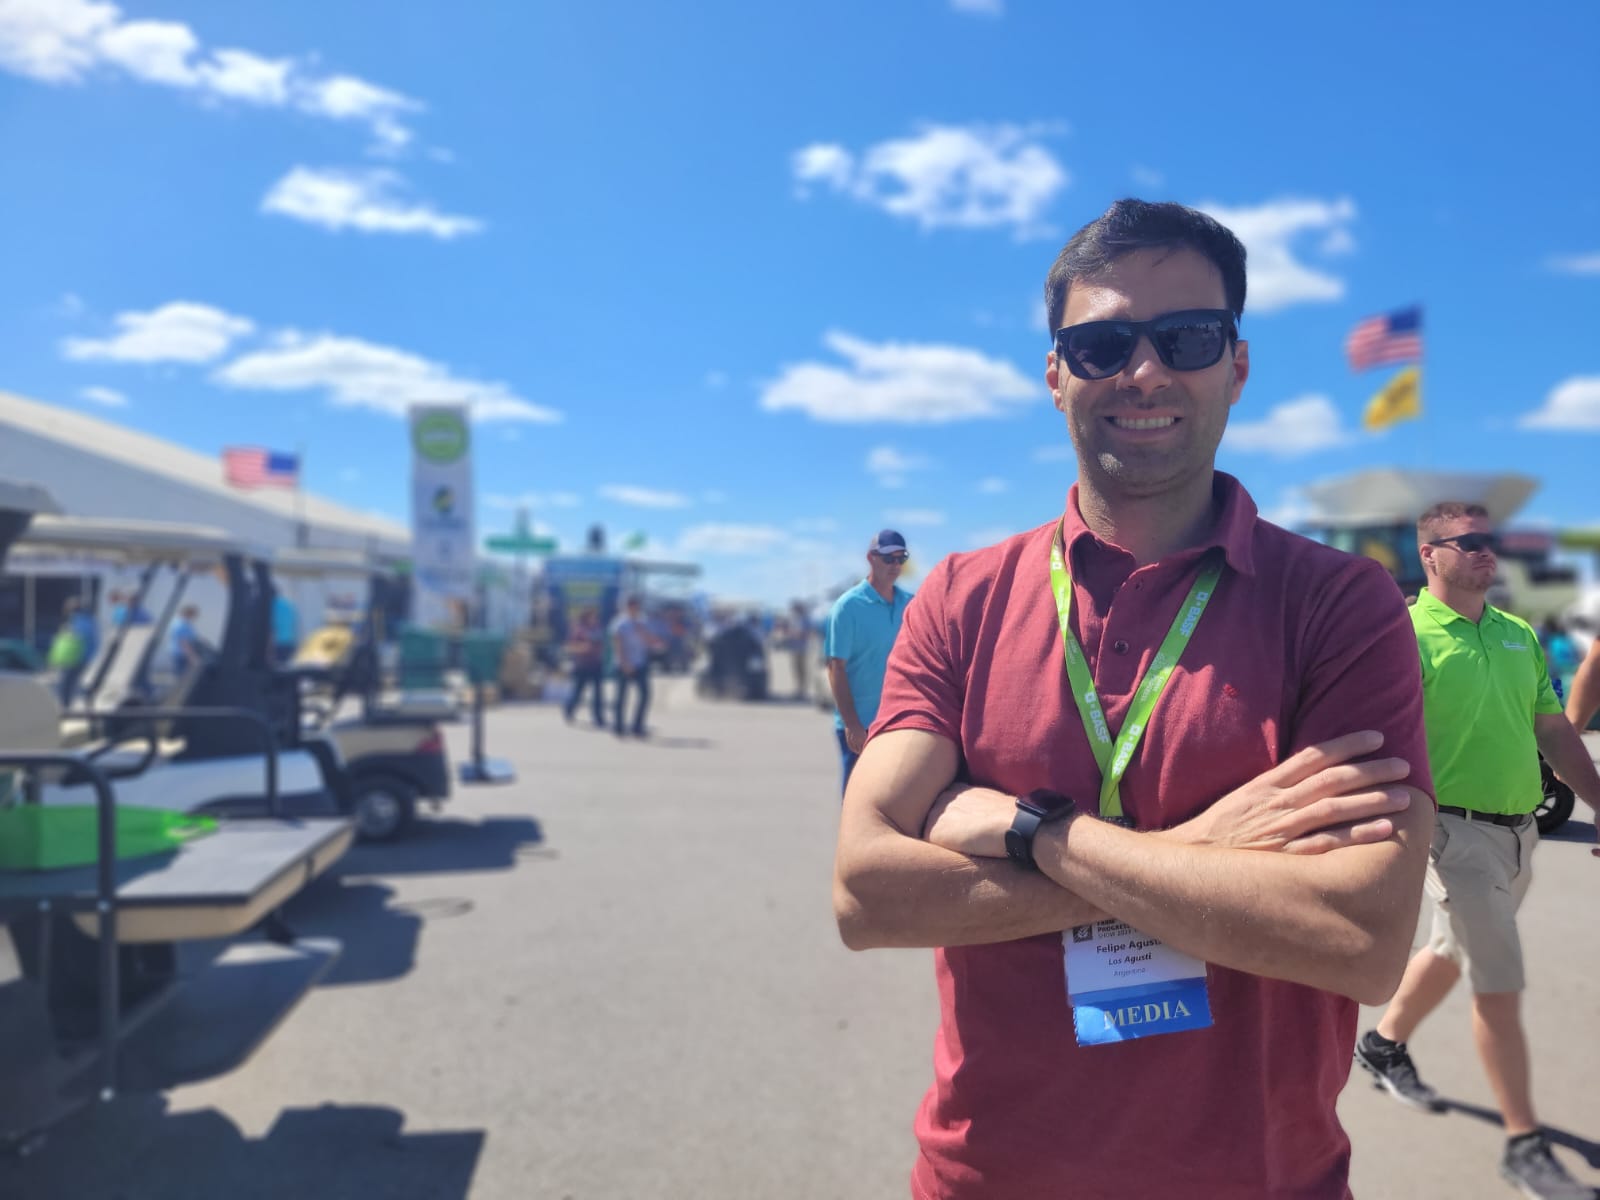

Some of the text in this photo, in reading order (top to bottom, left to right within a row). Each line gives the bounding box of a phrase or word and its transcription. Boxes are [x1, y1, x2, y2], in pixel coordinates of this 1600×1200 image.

[1180, 604, 1201, 637] BASF
[1090, 708, 1109, 744] BASF
[1112, 739, 1134, 776] BASF
[1097, 943, 1126, 954] Felipe
[1108, 958, 1122, 966] Los
[1103, 999, 1192, 1031] MEDIA
